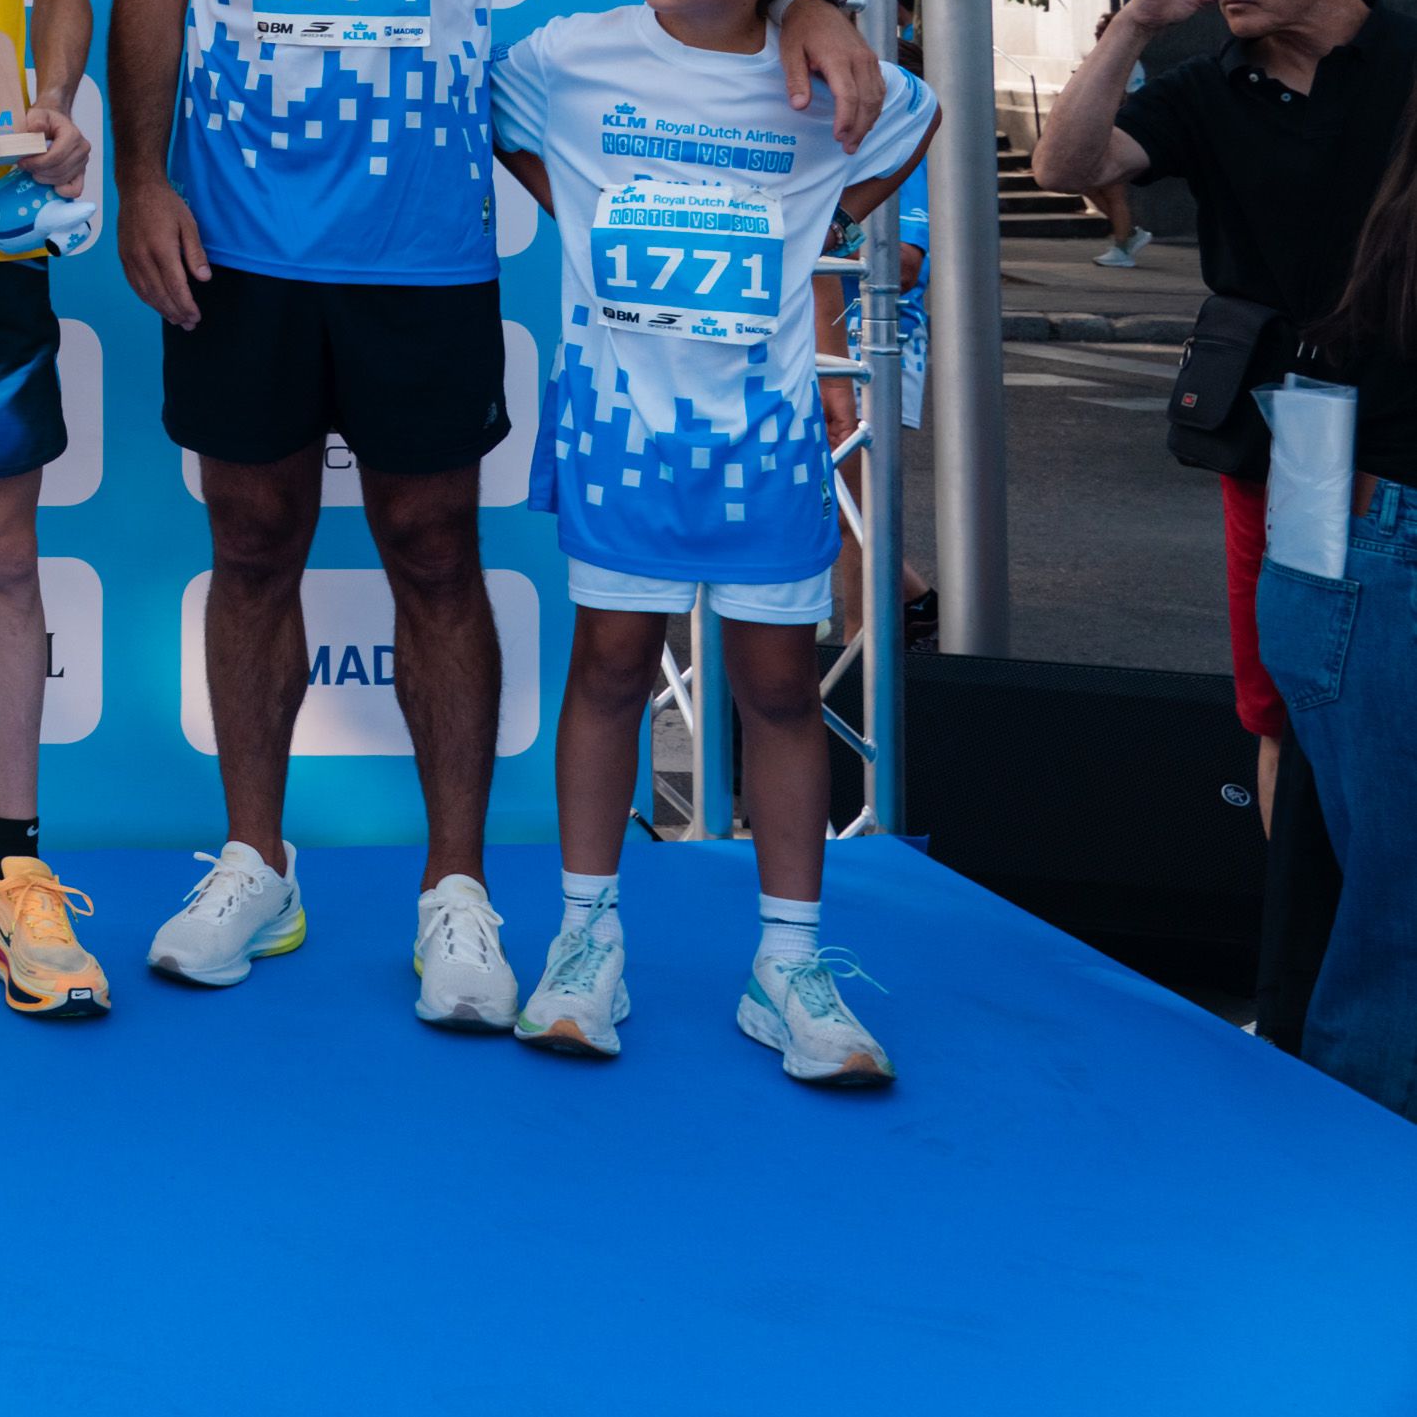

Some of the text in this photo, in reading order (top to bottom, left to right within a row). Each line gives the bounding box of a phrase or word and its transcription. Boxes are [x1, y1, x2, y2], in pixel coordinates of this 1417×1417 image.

[270, 22, 293, 34] BM
[343, 30, 377, 41] KLM
[393, 27, 424, 35] MADRID
[602, 114, 797, 146] KLM Royal Dutch Airlines
[603, 133, 793, 172] NORTE VS SUR
[611, 194, 767, 212] KLM Royal Dutch Airlines
[610, 209, 768, 233] NORTE VS SUR
[606, 244, 769, 300] 1771
[616, 310, 640, 324] BM
[691, 325, 727, 337] KLM
